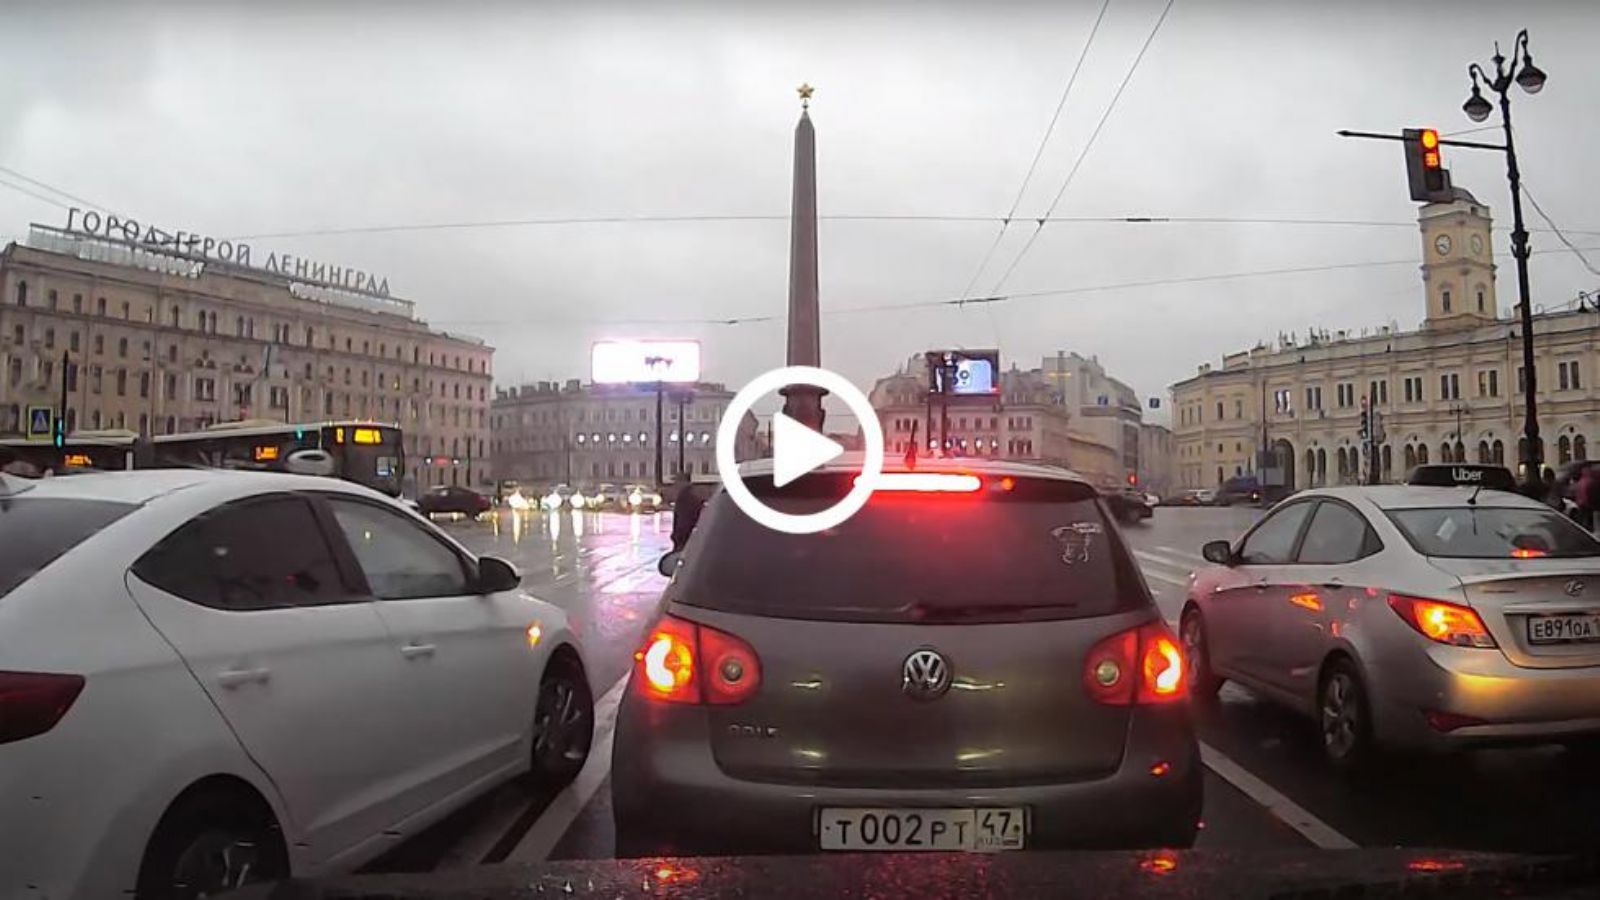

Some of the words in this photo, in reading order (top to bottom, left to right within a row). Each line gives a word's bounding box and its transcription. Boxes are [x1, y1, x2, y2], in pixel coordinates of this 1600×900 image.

[265, 251, 390, 297] ЛЕНИНГРАД
[1451, 467, 1484, 481] Uber
[982, 811, 1011, 837] 47
